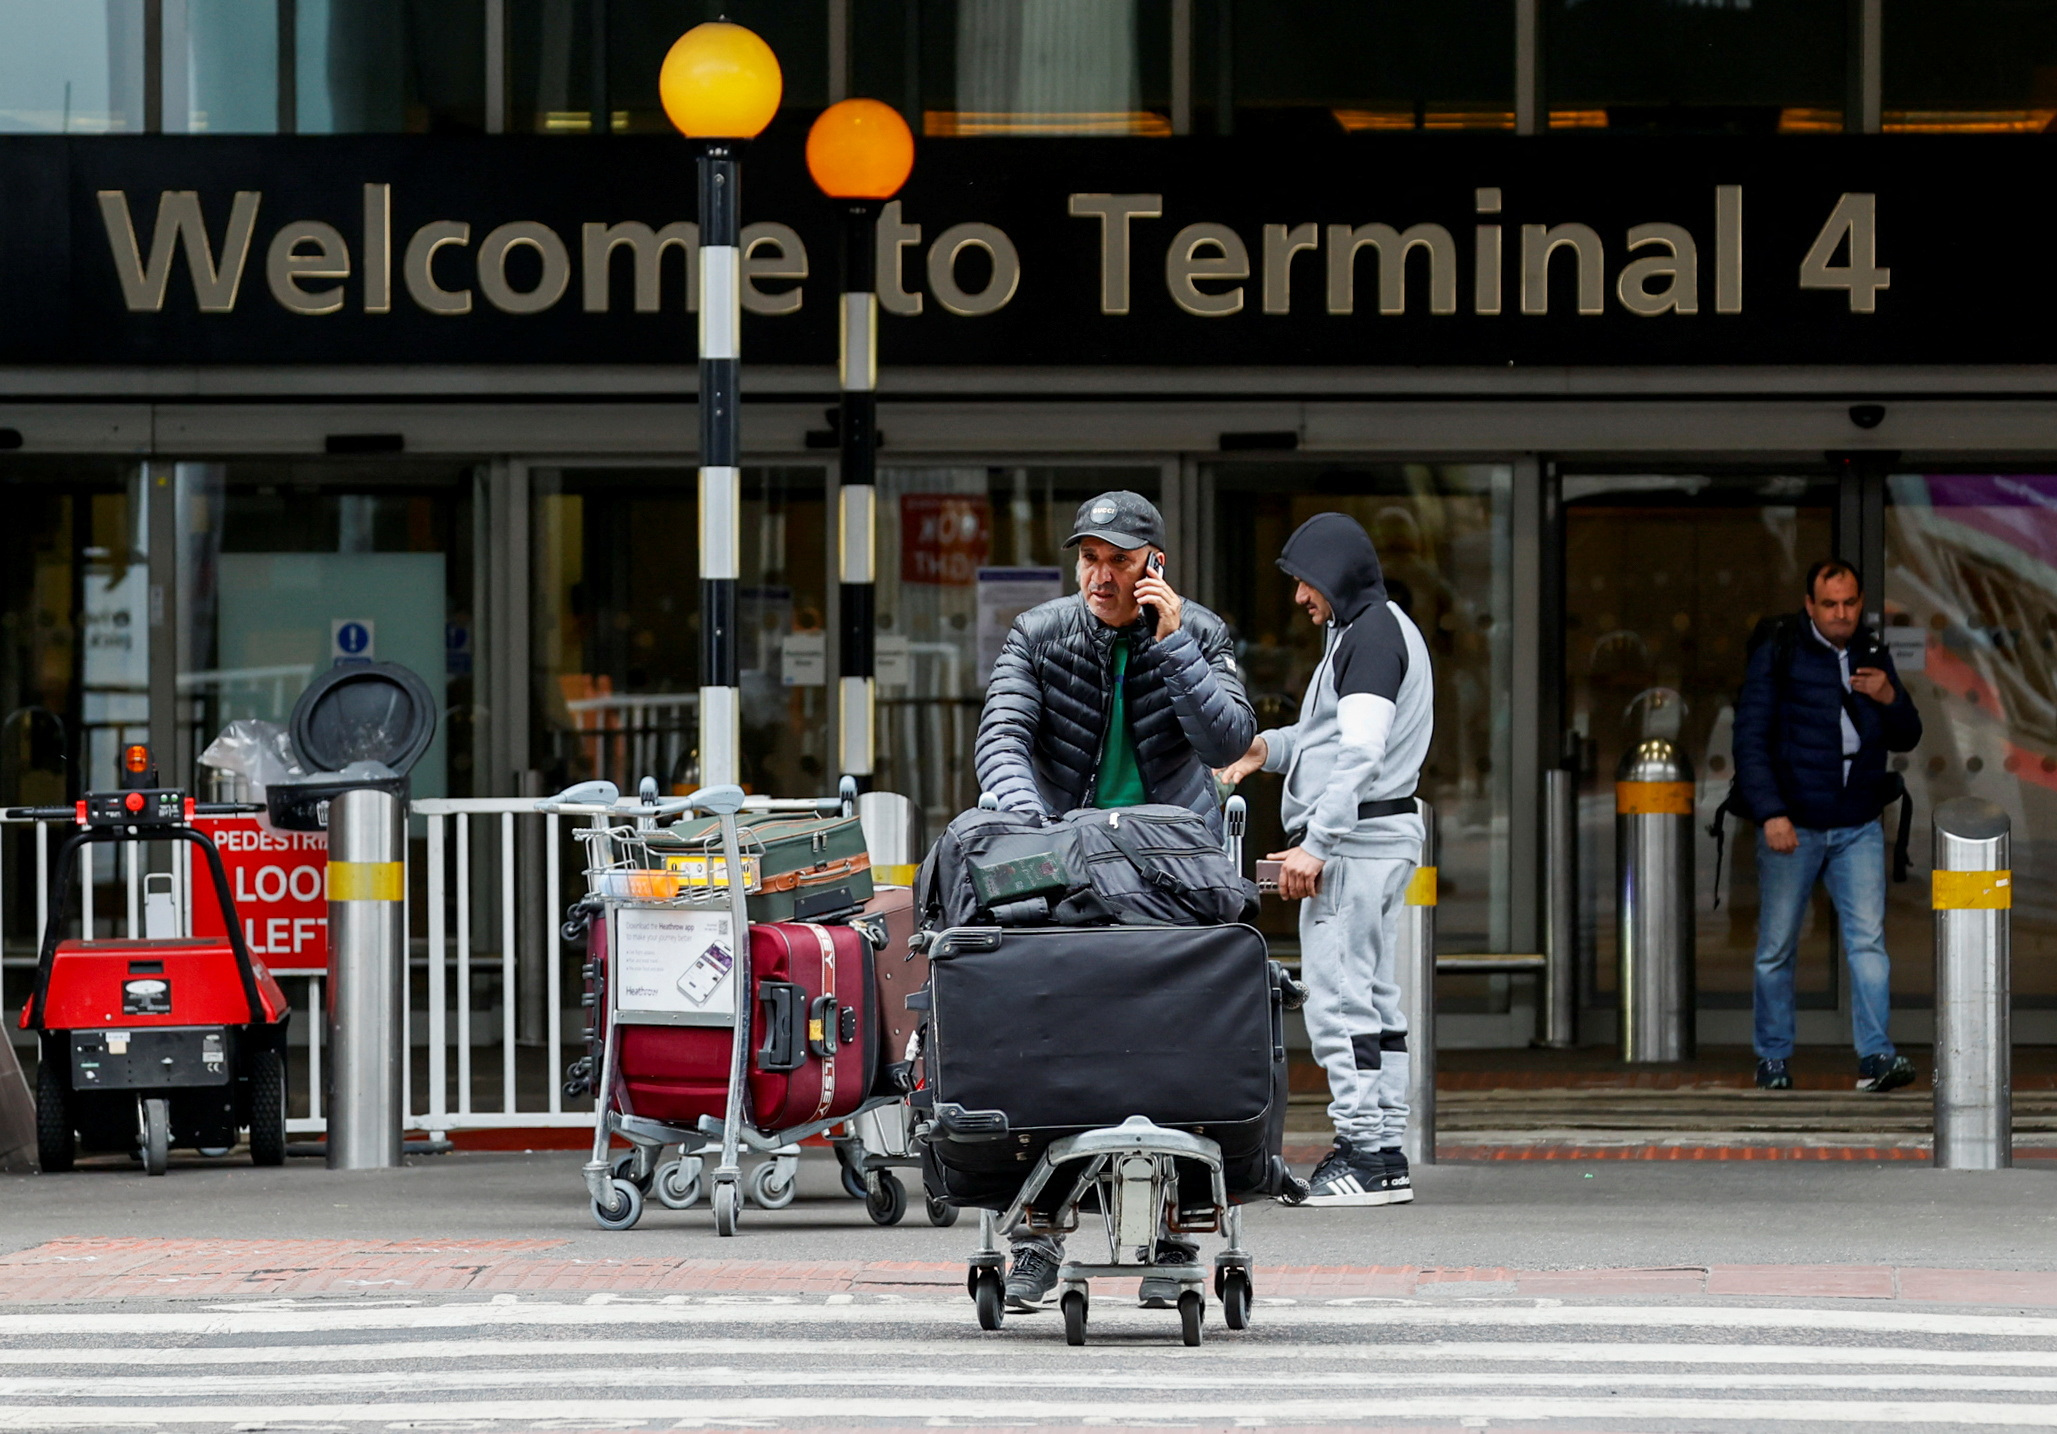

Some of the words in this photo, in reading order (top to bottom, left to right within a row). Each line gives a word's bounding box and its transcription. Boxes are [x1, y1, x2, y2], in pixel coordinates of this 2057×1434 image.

[97, 183, 809, 315] Welcome
[876, 200, 1020, 316] to
[1068, 184, 1742, 317] Terminal
[1800, 192, 1891, 314] 4
[1092, 506, 1115, 515] GUCCI
[235, 864, 328, 903] LOO
[658, 922, 684, 931] Heathrow
[684, 924, 695, 932] app
